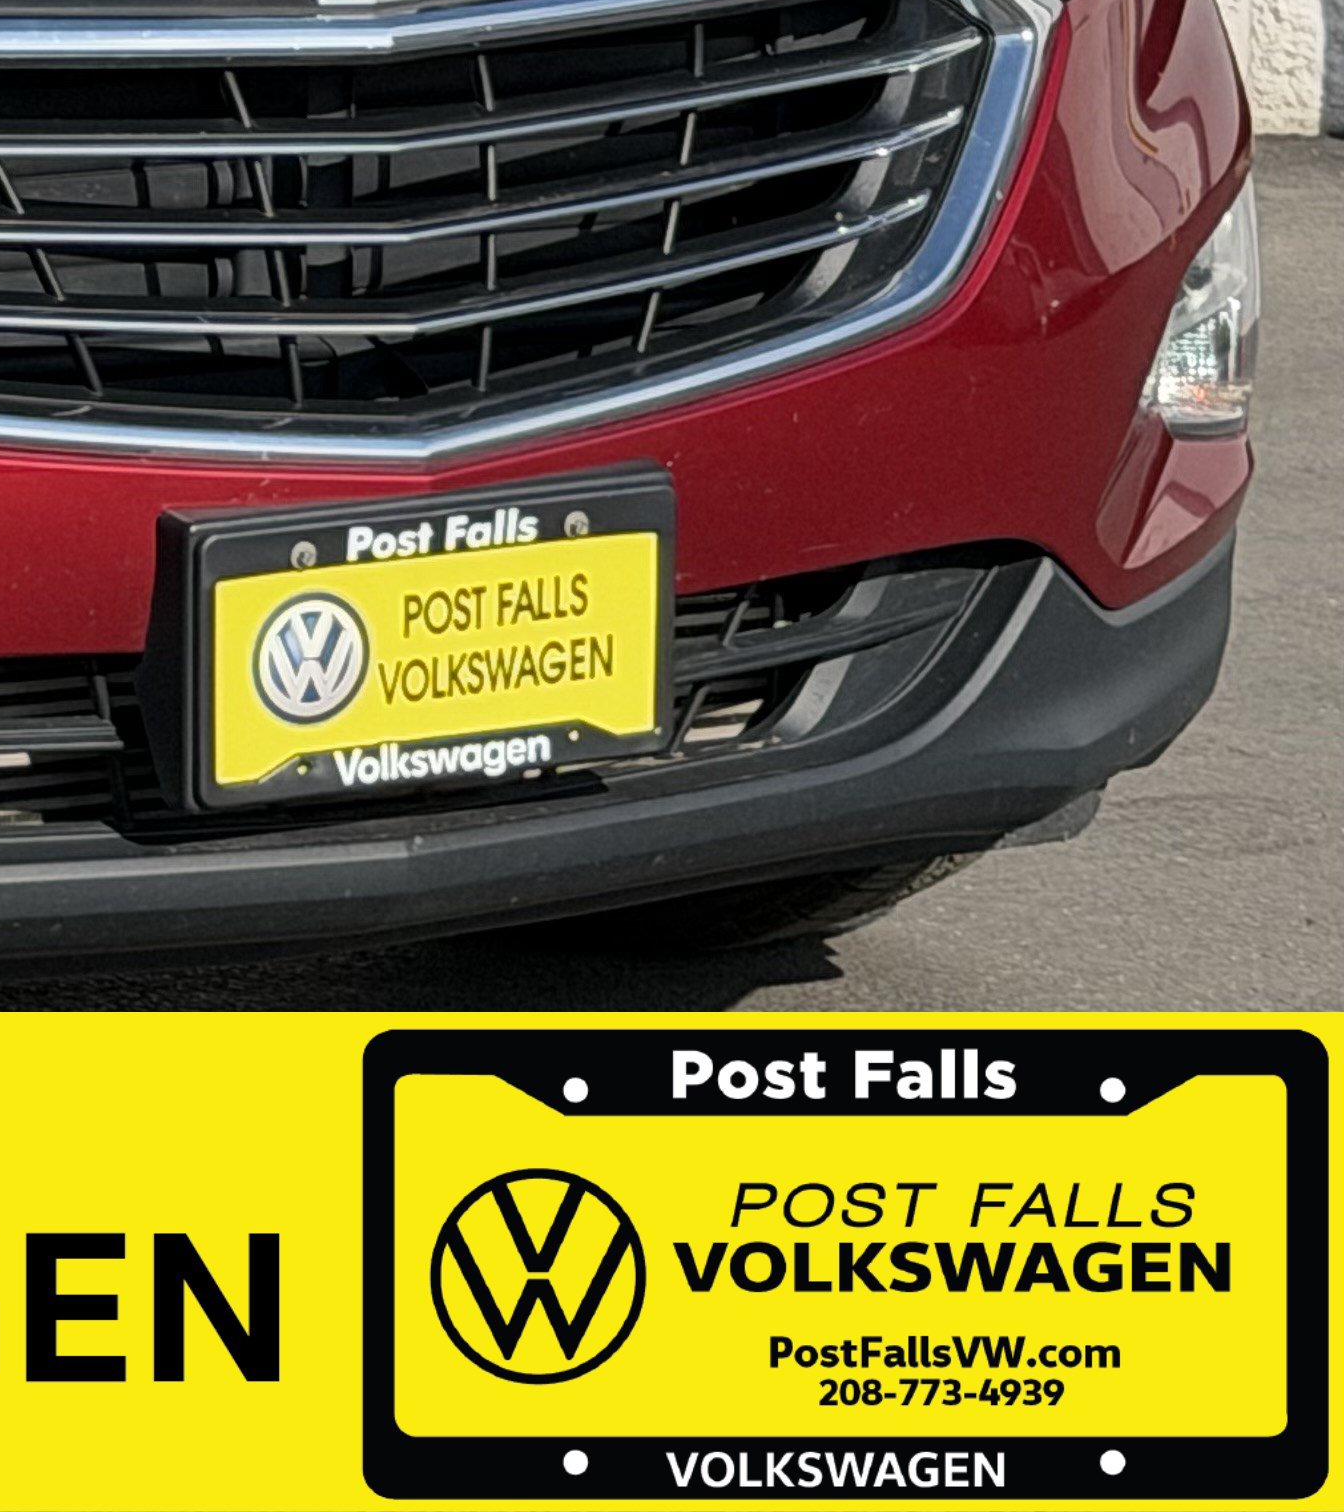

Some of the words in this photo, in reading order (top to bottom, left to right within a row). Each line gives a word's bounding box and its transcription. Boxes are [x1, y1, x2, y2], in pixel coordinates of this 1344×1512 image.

[346, 521, 434, 563] Post
[444, 507, 540, 552] Falls
[403, 586, 488, 639] POST
[497, 573, 589, 627] FALLS
[378, 634, 614, 705] VOLKSWAGEN
[333, 733, 552, 786] Volkswagen
